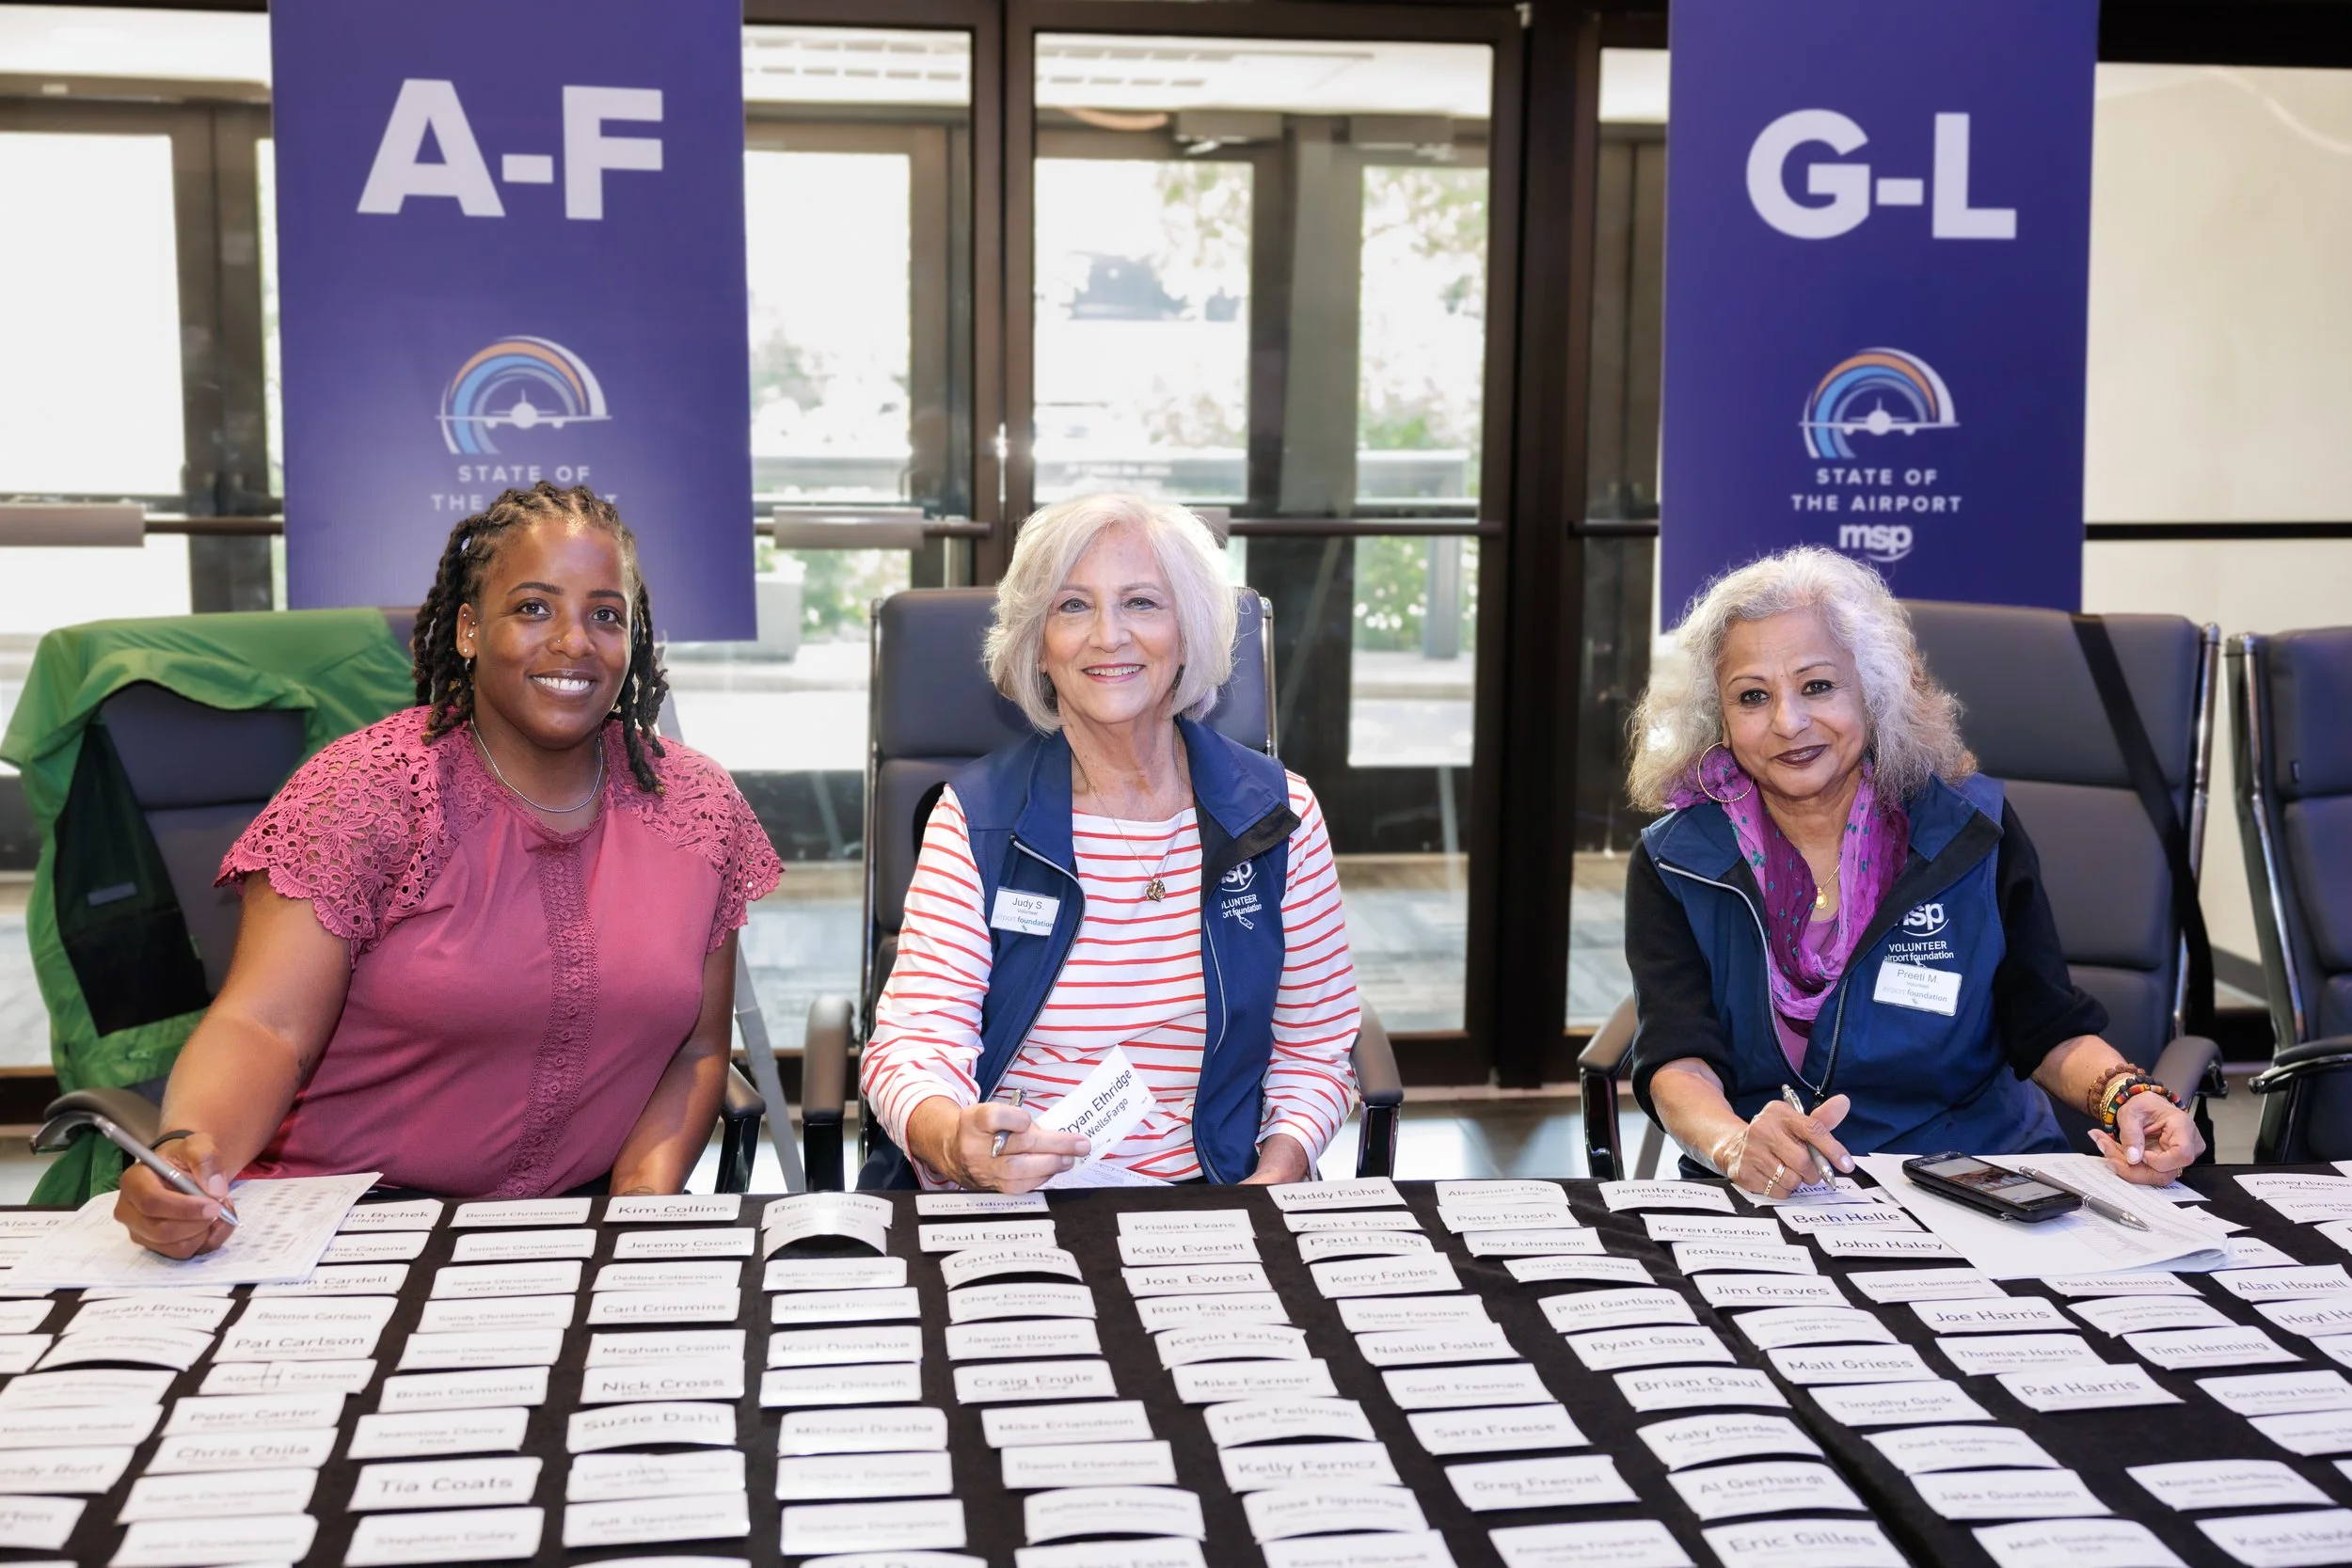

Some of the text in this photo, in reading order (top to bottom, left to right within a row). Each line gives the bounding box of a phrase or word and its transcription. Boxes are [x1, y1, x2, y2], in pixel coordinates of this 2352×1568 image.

[357, 78, 664, 220] A-F
[1746, 108, 2017, 240] G-L
[458, 466, 590, 483] STATE OF
[1816, 468, 1938, 485] STATE OF
[431, 494, 484, 512] THE
[1791, 495, 1963, 514] THE AIRPORT
[1840, 524, 1913, 554] msp
[1221, 859, 1253, 886] sp
[1012, 897, 1044, 911] Judy S.
[1232, 903, 1262, 917] foundation
[1888, 941, 1947, 953] VOLUNTEER
[1910, 951, 1954, 961] foundation
[1897, 969, 1926, 981] Preeti
[1907, 988, 1947, 1003] foundation
[1092, 1069, 1132, 1112] Ethridge
[1085, 1098, 1128, 1138] WellsFargo
[1282, 1187, 1387, 1201] Maddy Fisher
[1613, 1187, 1676, 1197] Jennifer
[617, 1204, 728, 1214] Kim Collins
[967, 1199, 1038, 1209] Eddington
[1457, 1211, 1557, 1222] Peter Frosch
[1792, 1211, 1900, 1224] Beth Helle
[931, 1230, 1043, 1242] Paul Eggen
[1658, 1225, 1771, 1237] Karen Gordon
[627, 1241, 688, 1250] Jeremy
[1310, 1234, 1359, 1245] Paul
[1481, 1240, 1507, 1248] Roy
[1833, 1239, 1943, 1251] John Haley
[1132, 1243, 1245, 1256] Kelly Everett
[1686, 1248, 1802, 1262] Robert Grace
[953, 1250, 1068, 1269] Carol Eiden
[325, 1275, 389, 1285] Cardell
[1140, 1273, 1255, 1286] Joe Ewest
[1331, 1267, 1438, 1284] Kerry Forbes
[1712, 1285, 1830, 1296] Jim Graves
[2236, 1278, 2349, 1291] Alan Howell
[88, 1303, 216, 1316] Sarah Brown
[603, 1302, 727, 1314] Carl Crimmins
[1151, 1305, 1190, 1314] Ron
[1556, 1296, 1676, 1314] Patti Gartland
[258, 1312, 373, 1321] Bonnie Carlson
[1934, 1308, 2051, 1323] Joe Harris
[2280, 1309, 2328, 1323] Hoyt
[233, 1337, 365, 1349] Pat Carlson
[1170, 1332, 1295, 1348] Kevin Farley
[1591, 1336, 1706, 1352] Ryan Gaug
[2149, 1339, 2269, 1354] Tim Henning
[1373, 1342, 1436, 1354] Natalie
[1957, 1346, 2082, 1358] Thomas Harris
[1787, 1357, 1914, 1370] Matt Griess
[602, 1378, 725, 1392] Nick Cross
[973, 1373, 1094, 1388] Craig Engle
[1194, 1377, 1240, 1387] Mike
[1634, 1377, 1764, 1393] Brian Gaul
[2022, 1379, 2142, 1397] Pat Harris
[188, 1407, 322, 1423] Peter Carter
[582, 1411, 722, 1432] Suzie Dahl
[1222, 1411, 1268, 1424] Tess
[1664, 1430, 1709, 1444] Katy
[175, 1444, 310, 1461] Chris Chila
[1237, 1460, 1295, 1475] Kelly
[379, 1476, 515, 1493] Tia Coats
[1473, 1478, 1522, 1494] Greg
[1699, 1481, 1721, 1494] Al
[1729, 1531, 1877, 1553] Eric Gilles
